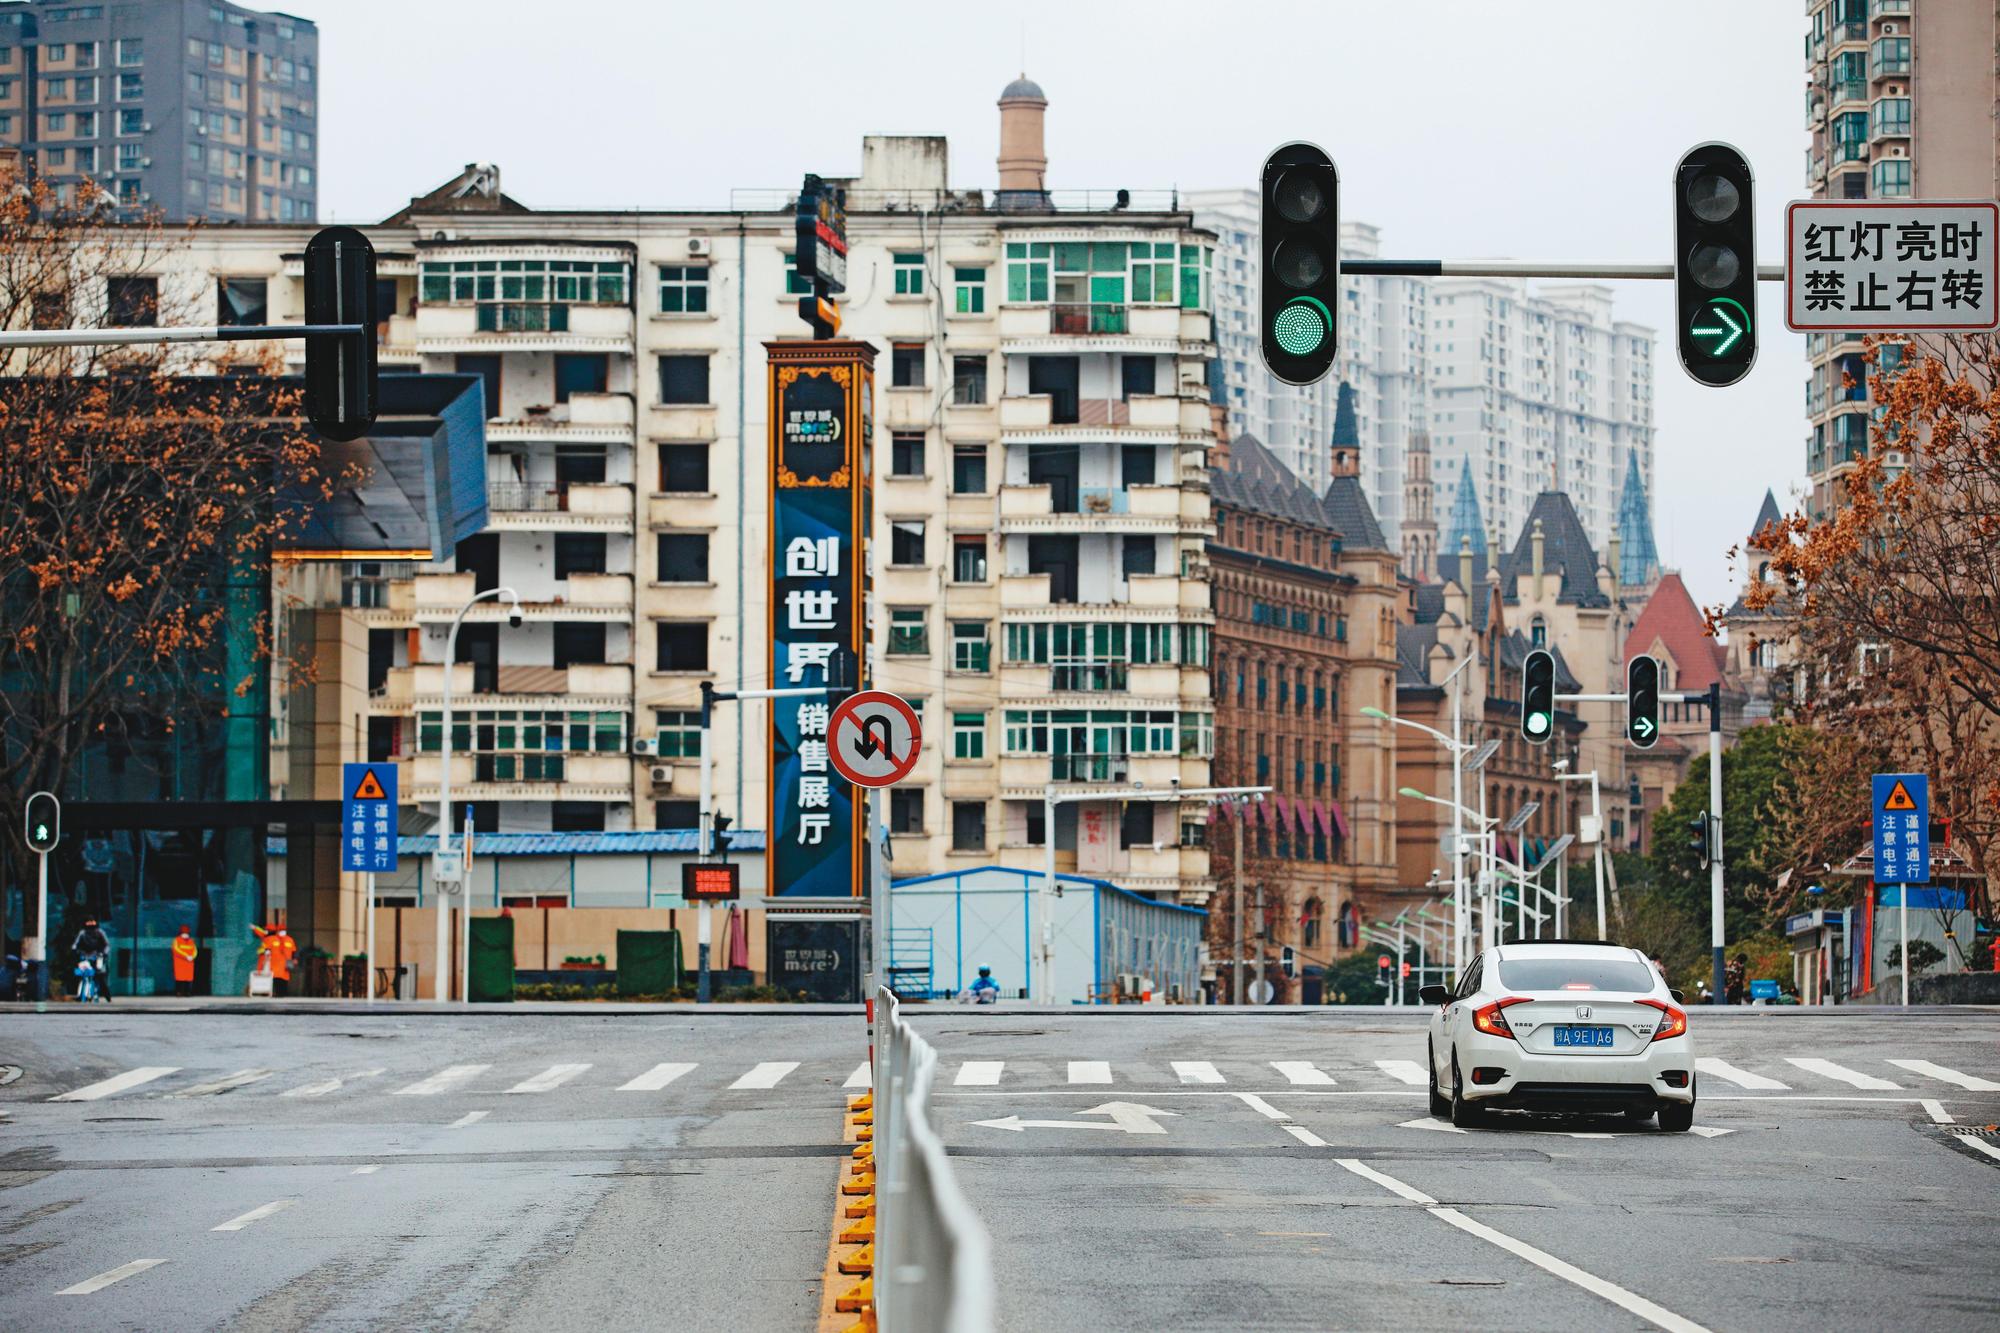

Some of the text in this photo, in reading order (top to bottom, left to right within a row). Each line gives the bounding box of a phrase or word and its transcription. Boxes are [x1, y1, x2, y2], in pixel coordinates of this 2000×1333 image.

[1804, 220, 1983, 262] 红灯亮时
[1804, 268, 1984, 311] 禁止右转
[784, 536, 839, 683] 创世界
[797, 703, 831, 845] 销售展厅
[351, 803, 366, 867] 注意电车
[374, 803, 389, 868] 谨慎通行
[1882, 814, 1898, 879] 注意电车
[1905, 814, 1920, 879] 谨慎通行
